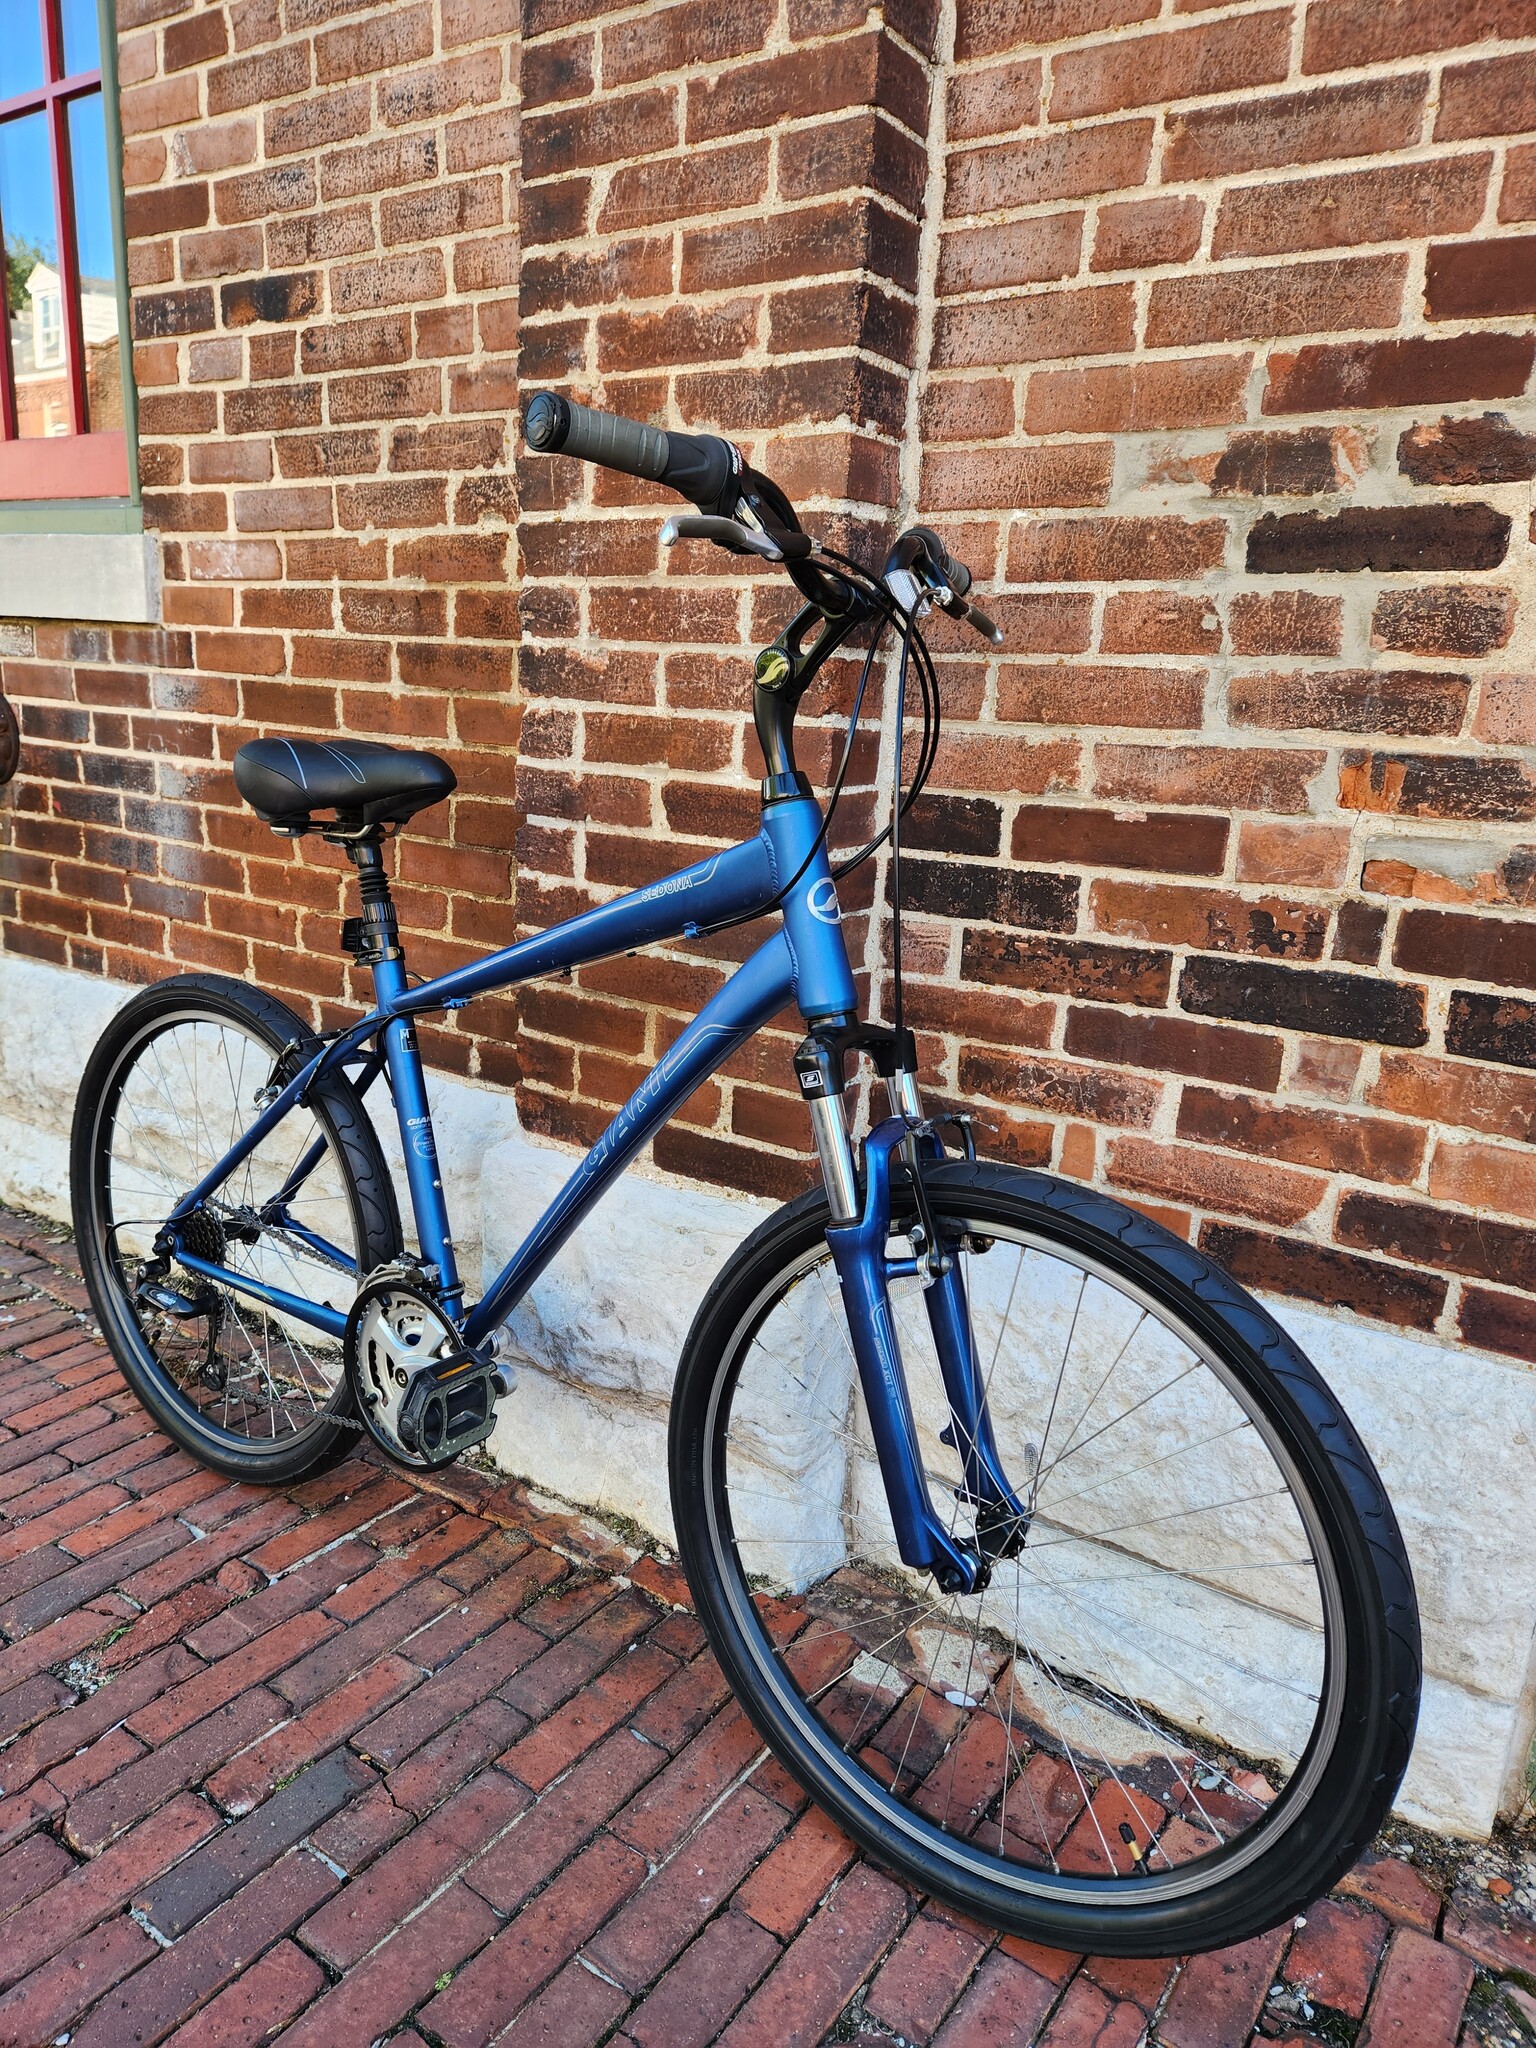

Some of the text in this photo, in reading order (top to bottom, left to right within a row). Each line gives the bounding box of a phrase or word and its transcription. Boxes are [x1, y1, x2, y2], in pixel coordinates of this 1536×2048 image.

[641, 874, 694, 902] SEDONA
[407, 1115, 431, 1126] GIAN
[583, 1050, 673, 1176] GIANT
